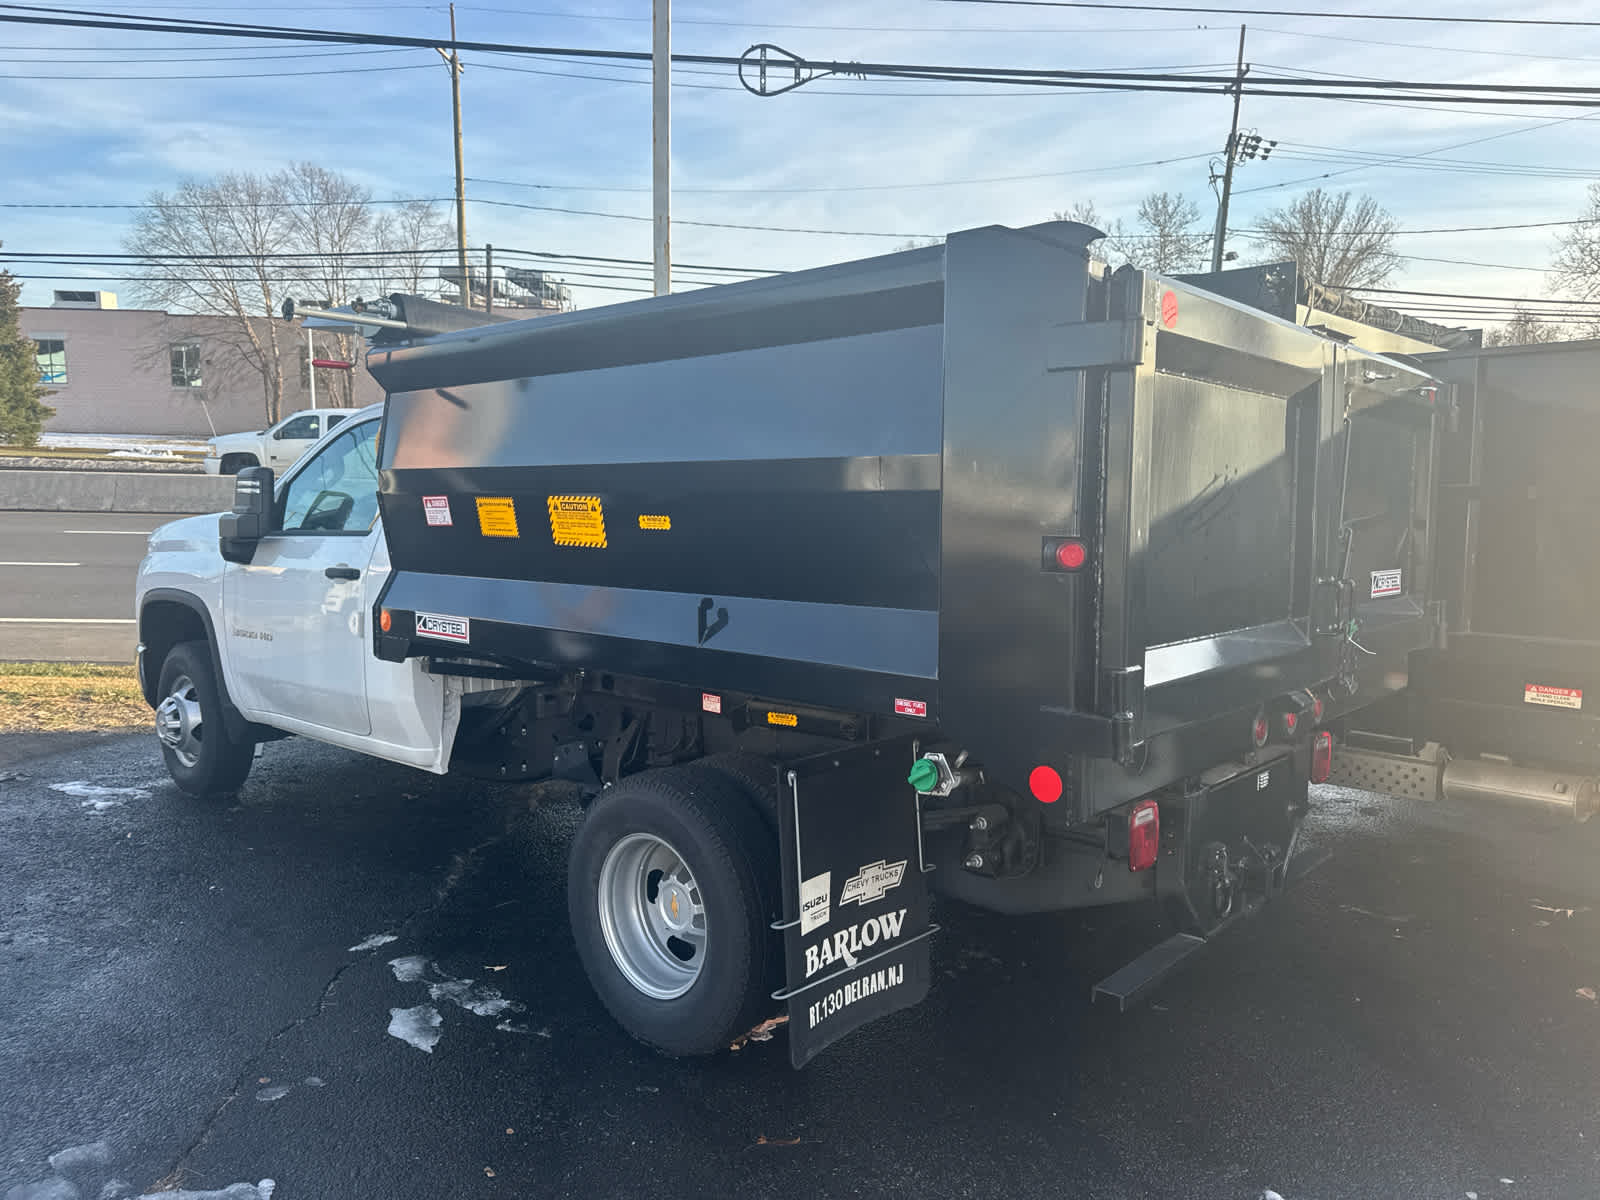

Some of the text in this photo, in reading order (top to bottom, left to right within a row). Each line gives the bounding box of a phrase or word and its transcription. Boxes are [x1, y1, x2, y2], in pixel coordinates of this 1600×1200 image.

[561, 502, 588, 511] CAUTION
[427, 619, 465, 635] CRYSTEEL
[1538, 686, 1568, 695] DANGER
[847, 869, 899, 892] CHEVY TRUCKS
[802, 893, 828, 912] ISUZU
[805, 908, 907, 978] BARLOW
[809, 988, 844, 1029] RT.130
